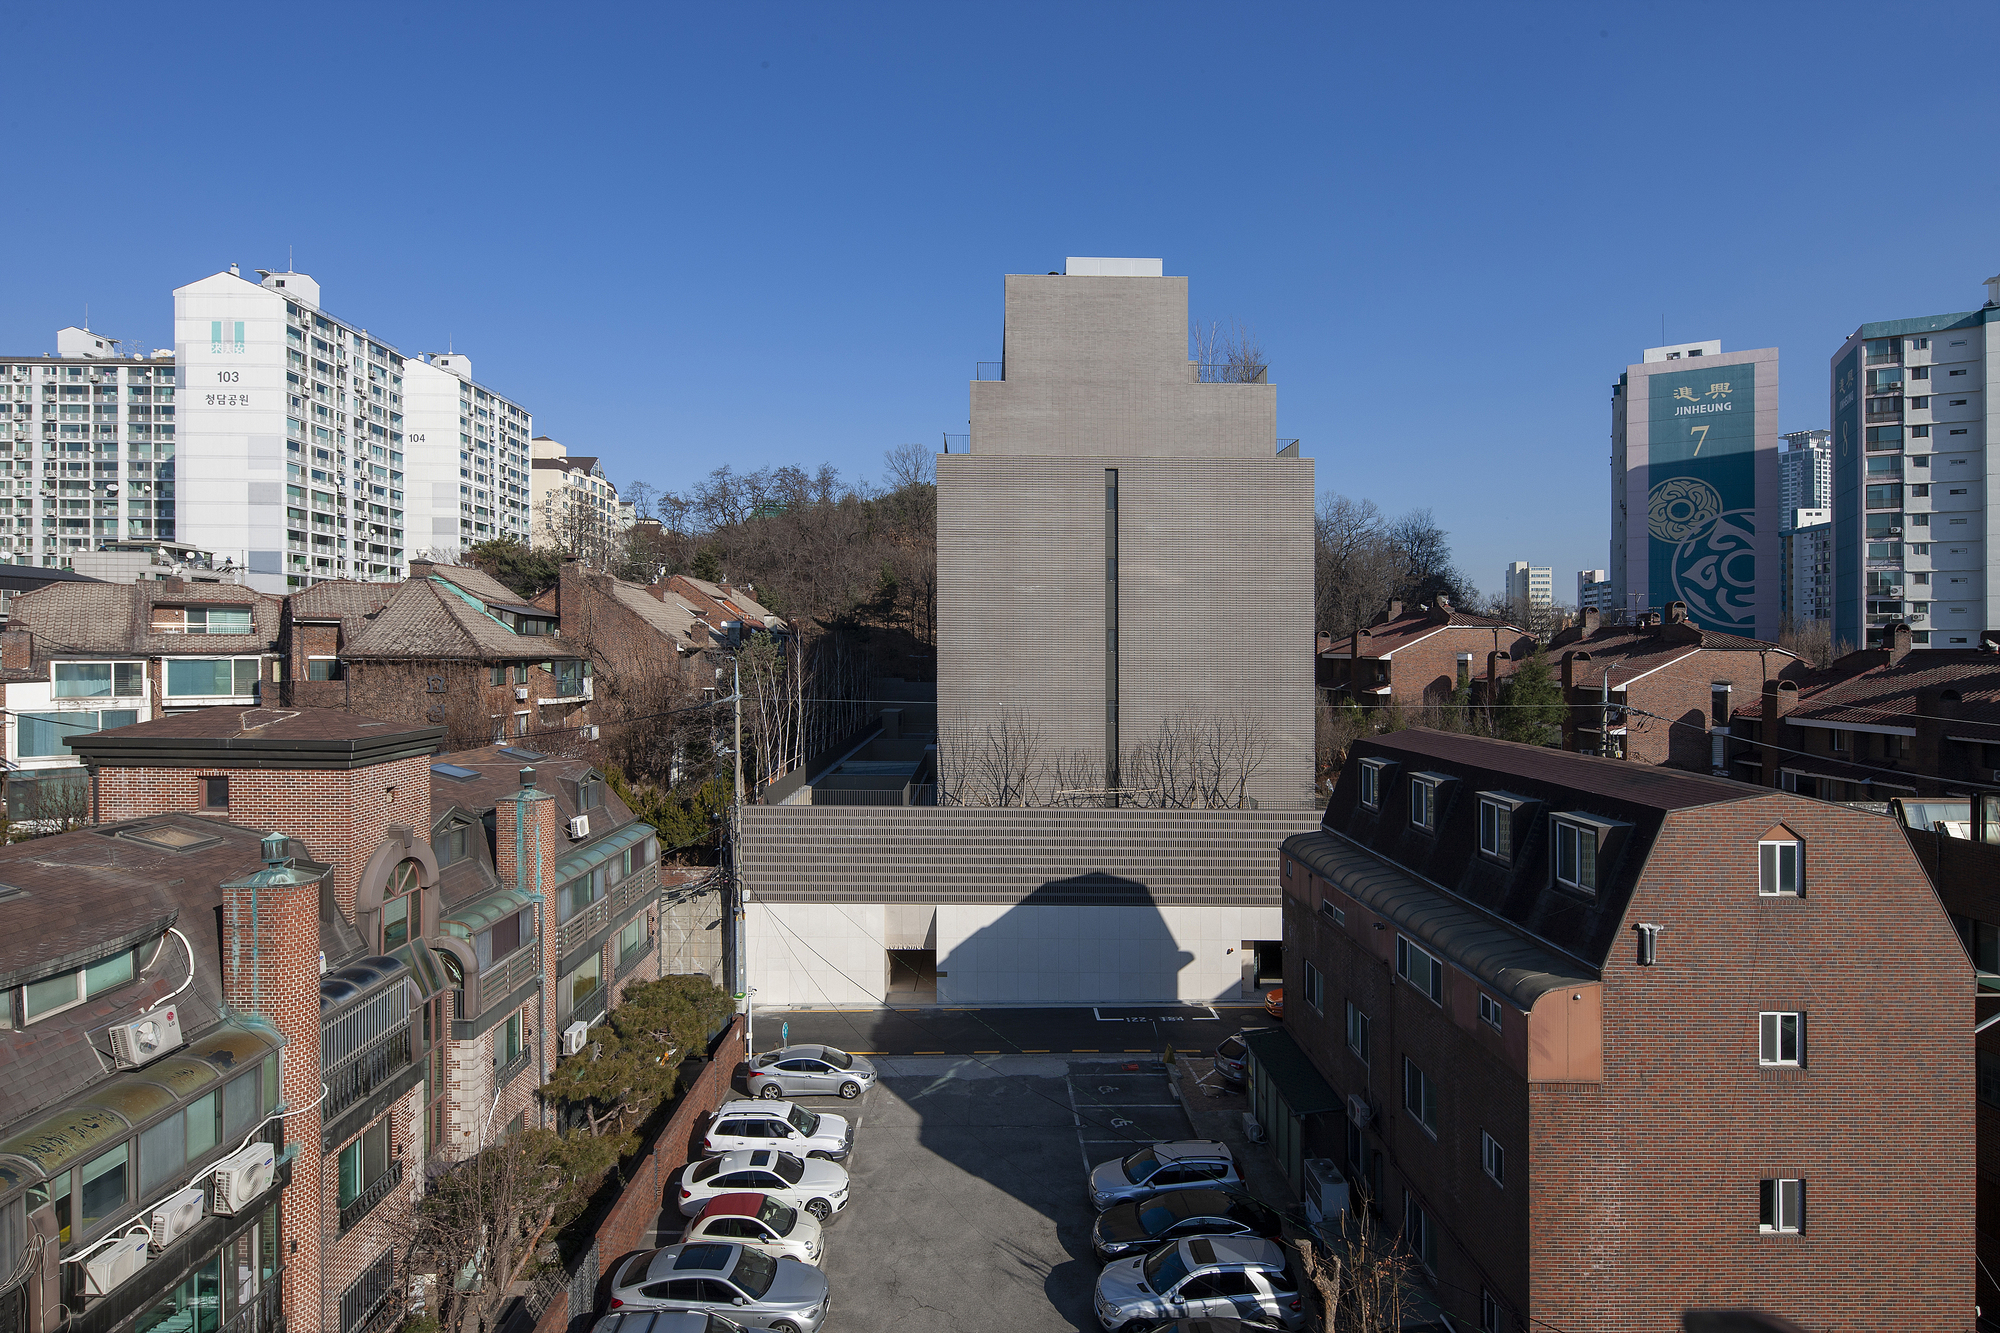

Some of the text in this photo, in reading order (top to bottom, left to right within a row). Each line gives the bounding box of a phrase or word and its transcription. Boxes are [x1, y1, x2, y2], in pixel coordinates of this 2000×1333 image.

[217, 371, 239, 383] 103
[205, 393, 249, 406] 청담공원
[1674, 402, 1732, 416] JINHEUNG
[409, 433, 426, 443] 104
[1690, 424, 1710, 457] 7
[1842, 420, 1849, 457] 8
